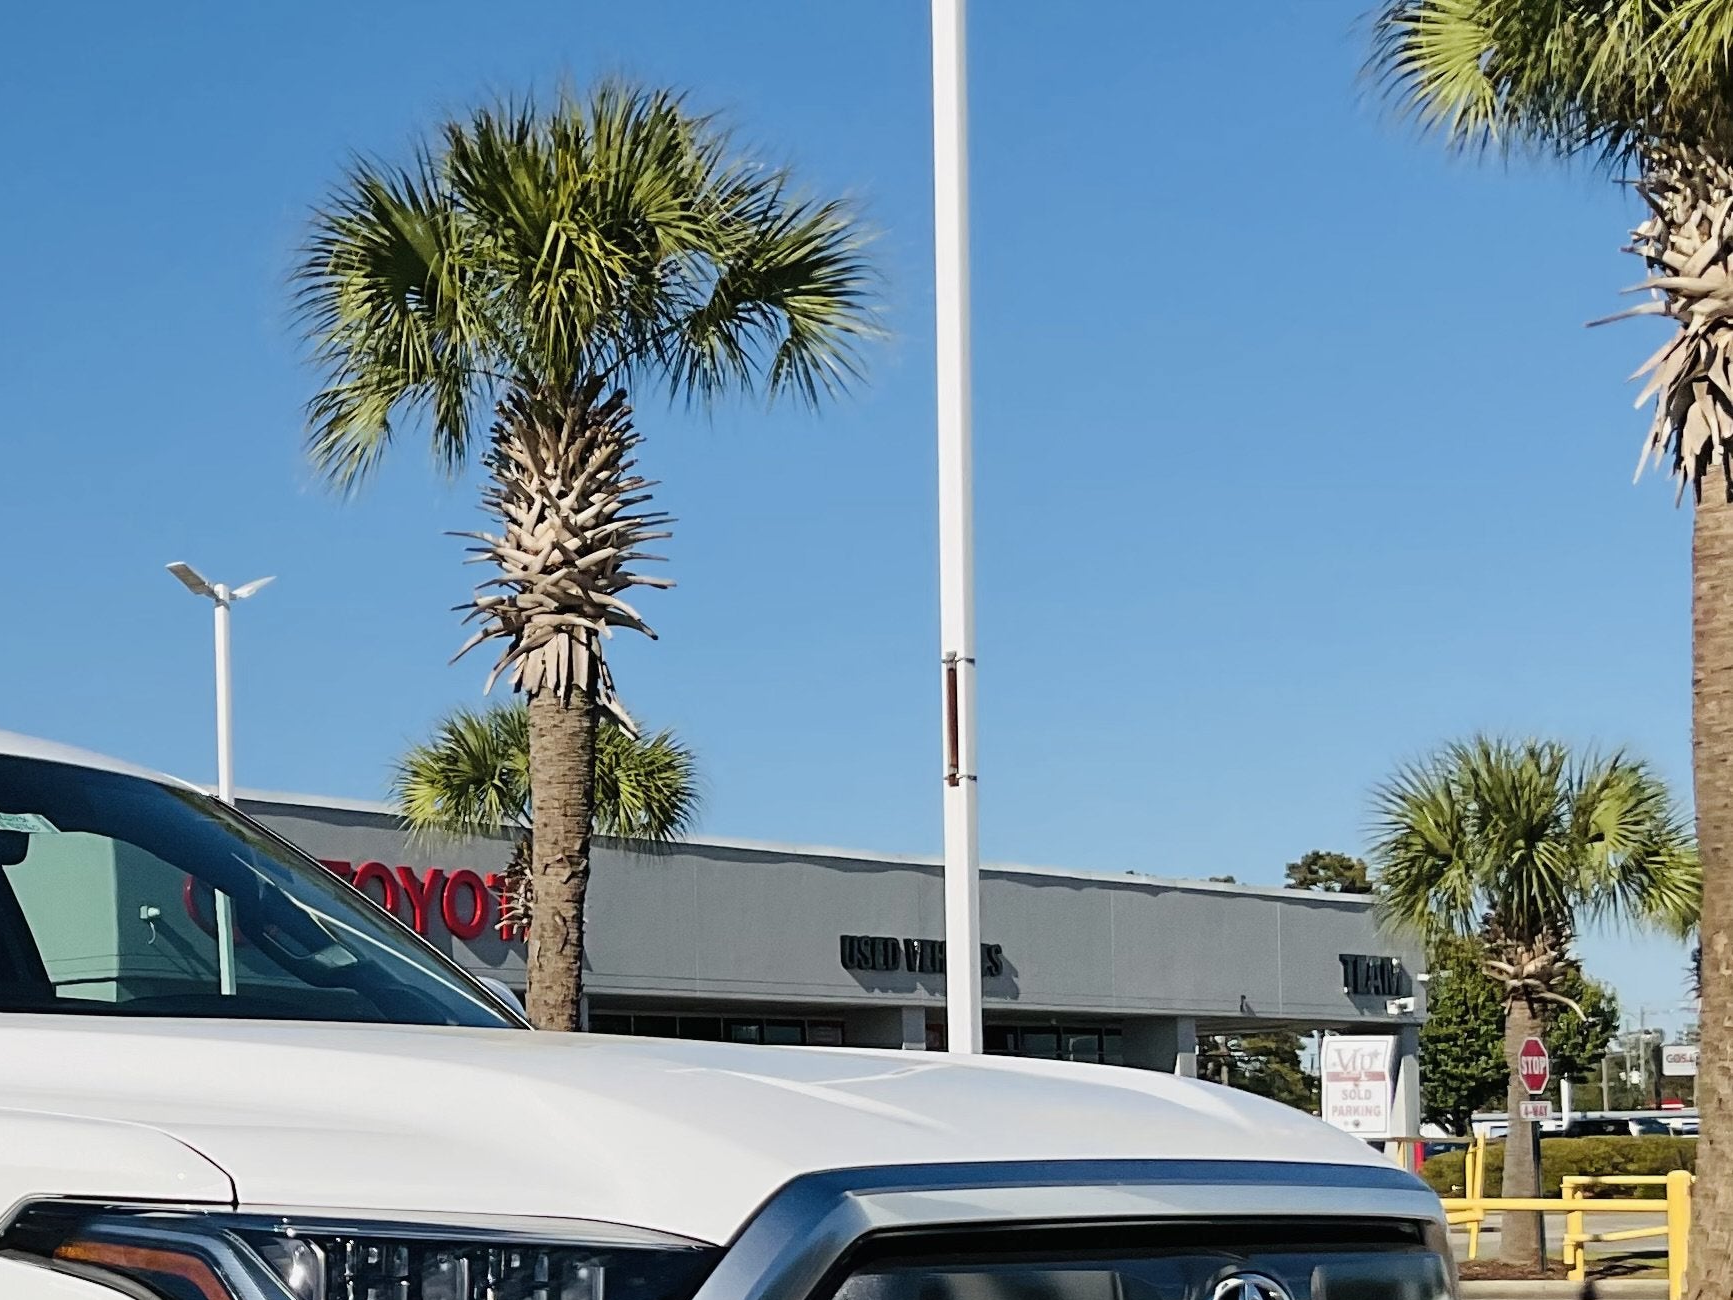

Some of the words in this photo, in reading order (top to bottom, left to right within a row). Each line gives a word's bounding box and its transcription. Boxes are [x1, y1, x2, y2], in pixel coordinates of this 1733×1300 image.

[317, 859, 529, 941] OYOT
[840, 935, 902, 970] USED
[1521, 1056, 1547, 1075] STOP
[1341, 1089, 1372, 1101] SOLD
[1331, 1105, 1381, 1117] PARKING
